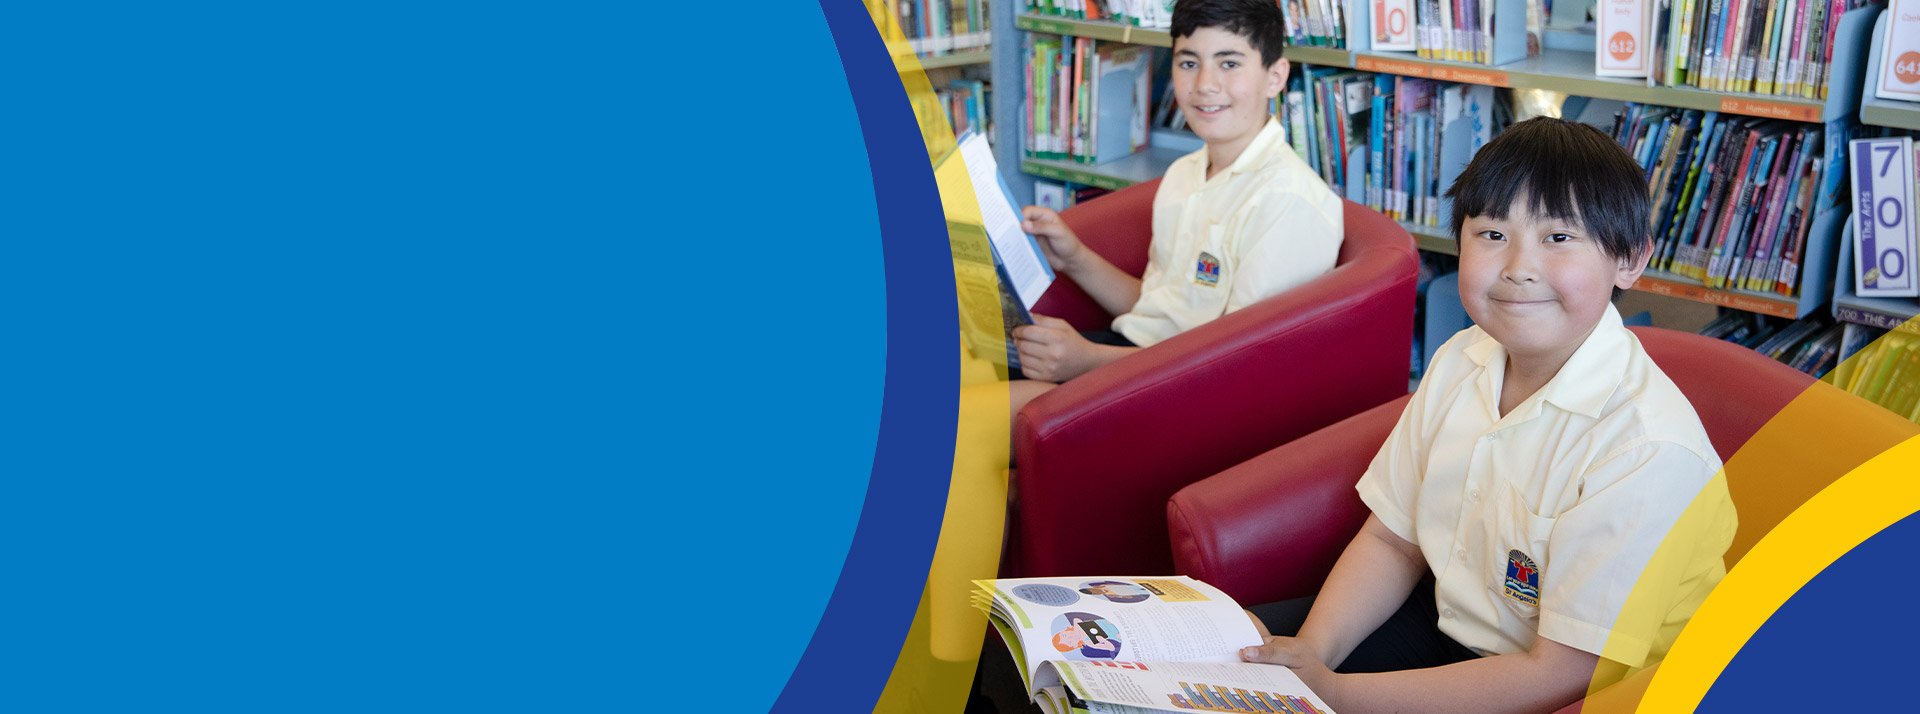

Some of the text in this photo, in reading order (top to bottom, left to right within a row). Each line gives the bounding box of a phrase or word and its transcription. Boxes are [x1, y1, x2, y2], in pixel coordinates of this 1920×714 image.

[1610, 41, 1635, 53] 612
[1374, 62, 1424, 76] TECHNOLOGY
[1722, 101, 1791, 117] 612 Human Body
[1861, 190, 1873, 241] The Arts
[1652, 283, 1671, 295] Cars
[1838, 309, 1858, 321] 700
[1863, 313, 1885, 326] THE
